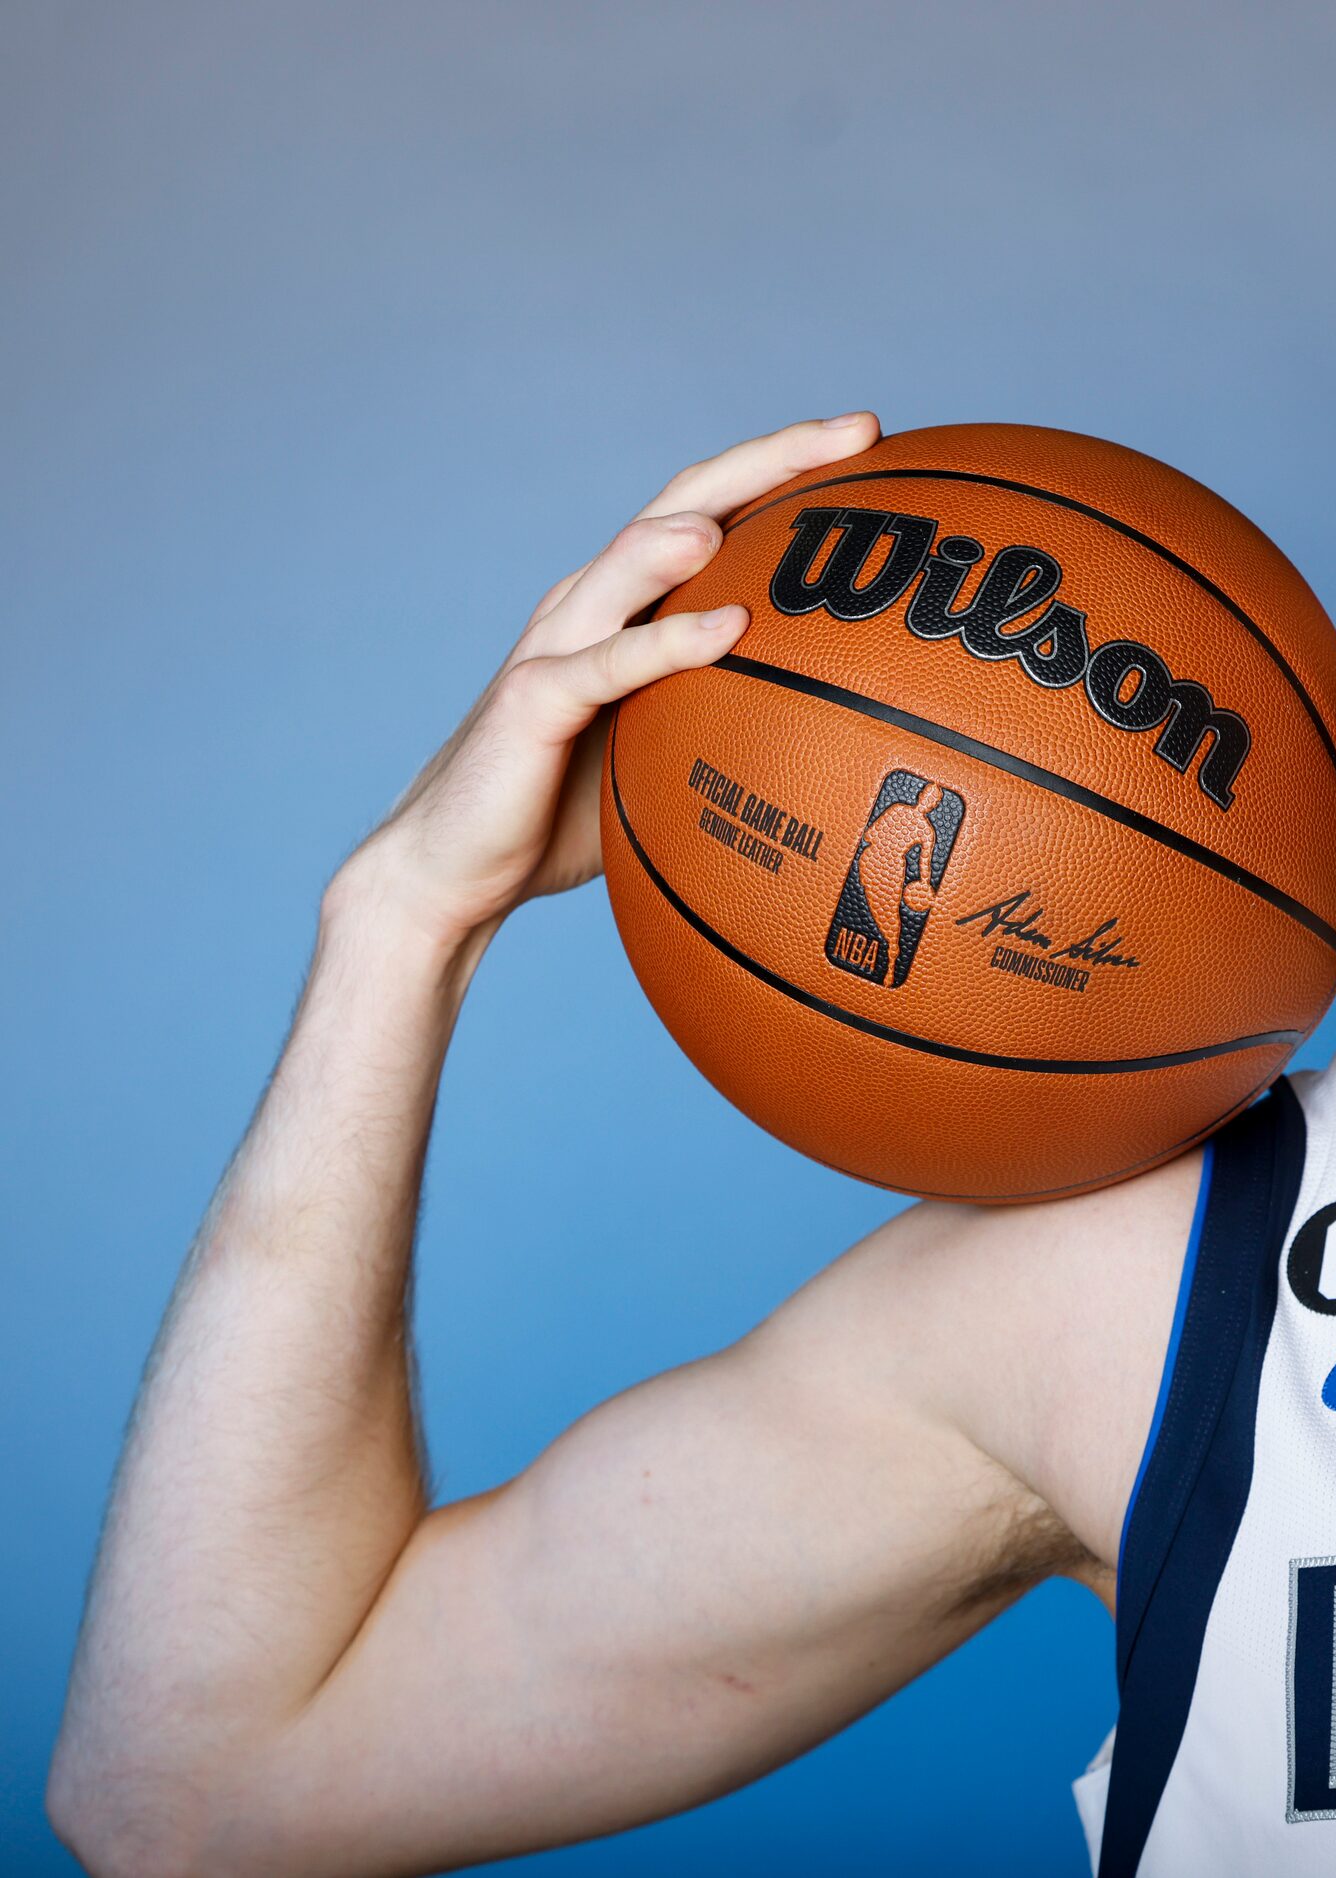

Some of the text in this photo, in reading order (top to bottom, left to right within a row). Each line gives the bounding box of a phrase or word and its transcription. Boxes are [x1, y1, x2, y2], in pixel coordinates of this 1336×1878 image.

[769, 507, 1252, 813] Wilson
[688, 758, 824, 862] OFFICIAL GAME BALL
[699, 807, 783, 875] GENUINE LEATHER
[833, 927, 879, 972] NBA
[990, 946, 1091, 993] COMMISSIONER
